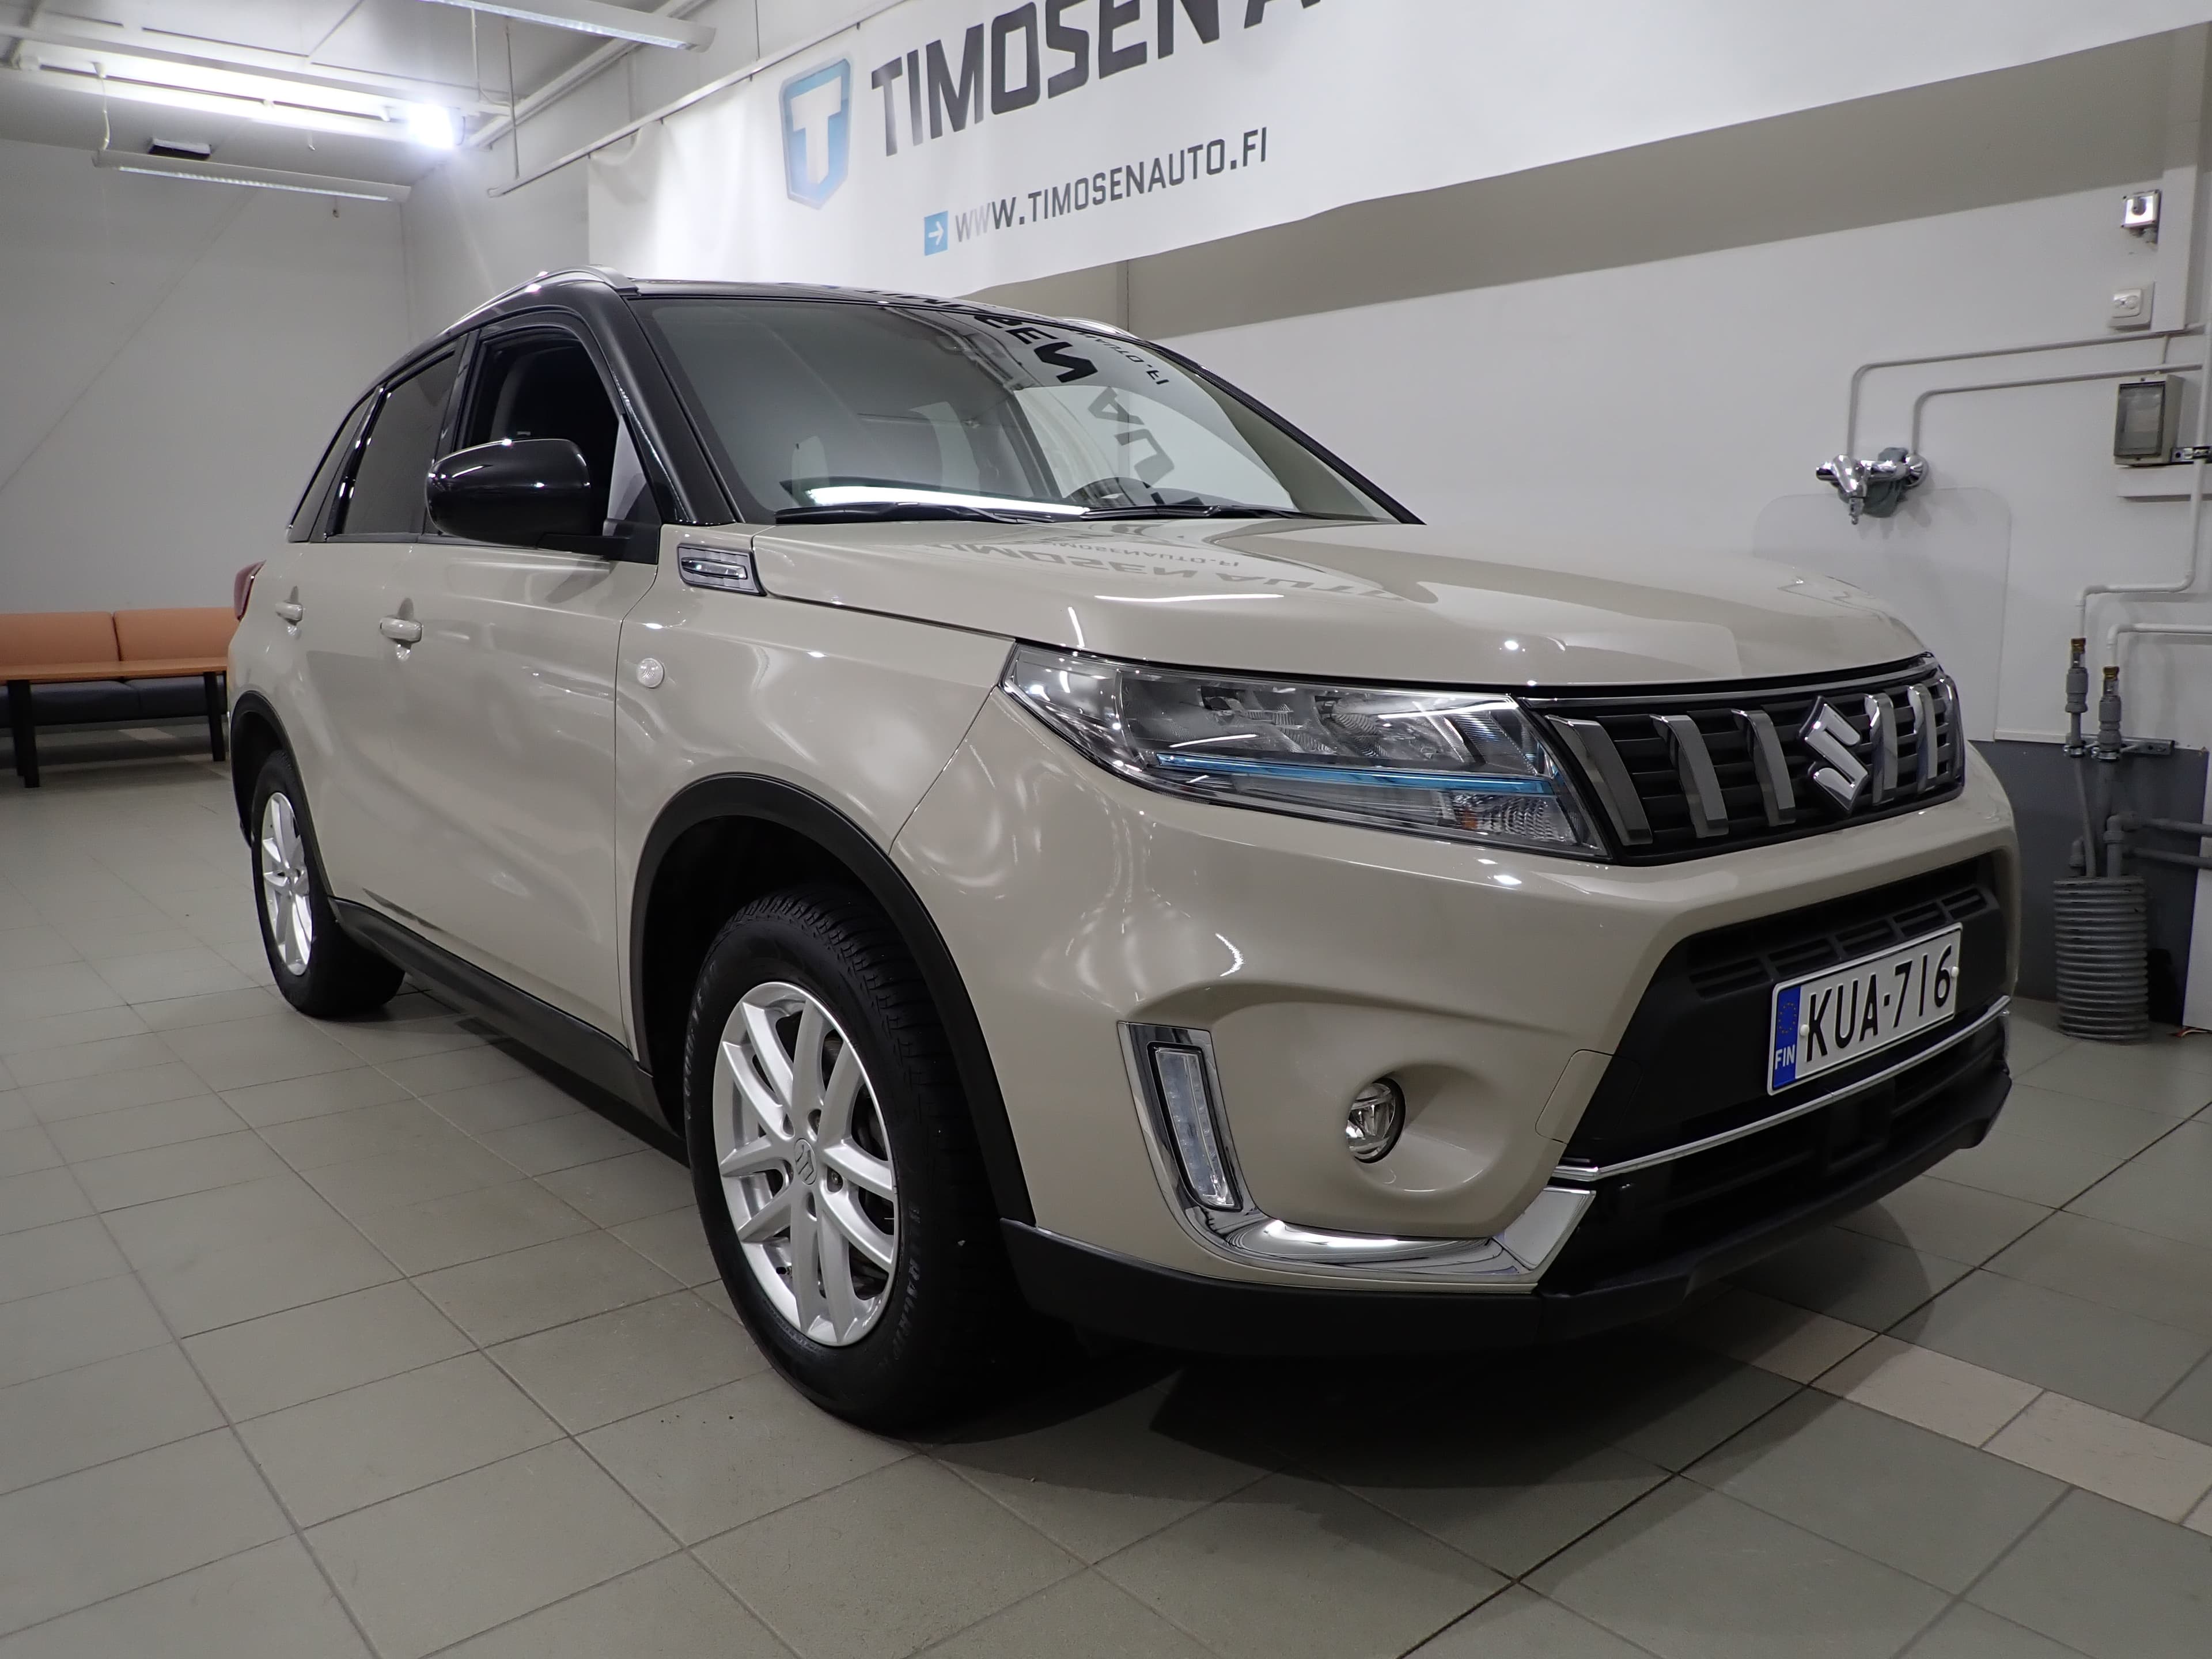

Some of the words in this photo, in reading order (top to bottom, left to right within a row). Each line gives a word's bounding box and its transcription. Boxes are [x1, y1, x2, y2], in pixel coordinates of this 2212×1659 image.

[955, 127, 1267, 243] WWW.TIMOSENAUTO.FI
[1774, 1043, 1796, 1070] FIN
[1806, 943, 1952, 1063] KUA-716
